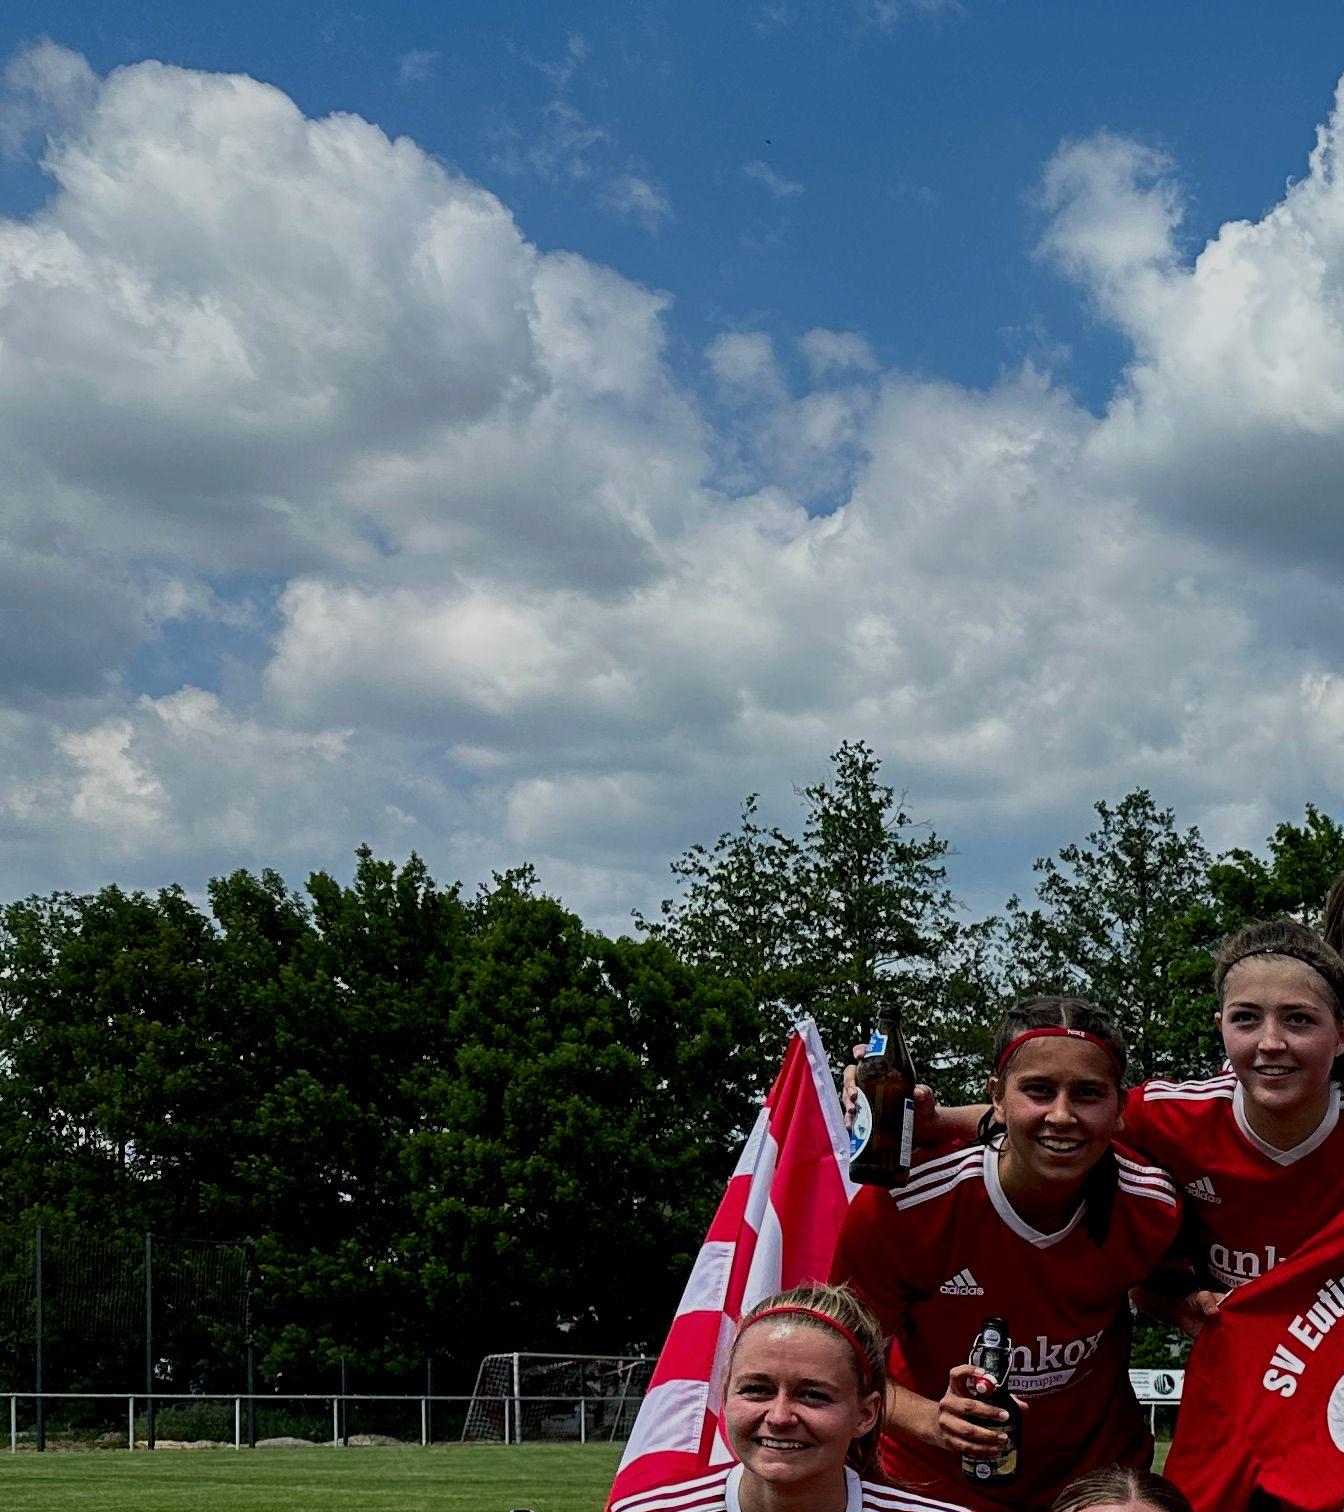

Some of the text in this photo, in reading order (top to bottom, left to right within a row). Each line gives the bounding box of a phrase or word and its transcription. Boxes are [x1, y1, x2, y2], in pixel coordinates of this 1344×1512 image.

[939, 1284, 984, 1296] adidas
[973, 1329, 1103, 1372] nkox
[1263, 1344, 1306, 1397] SV
